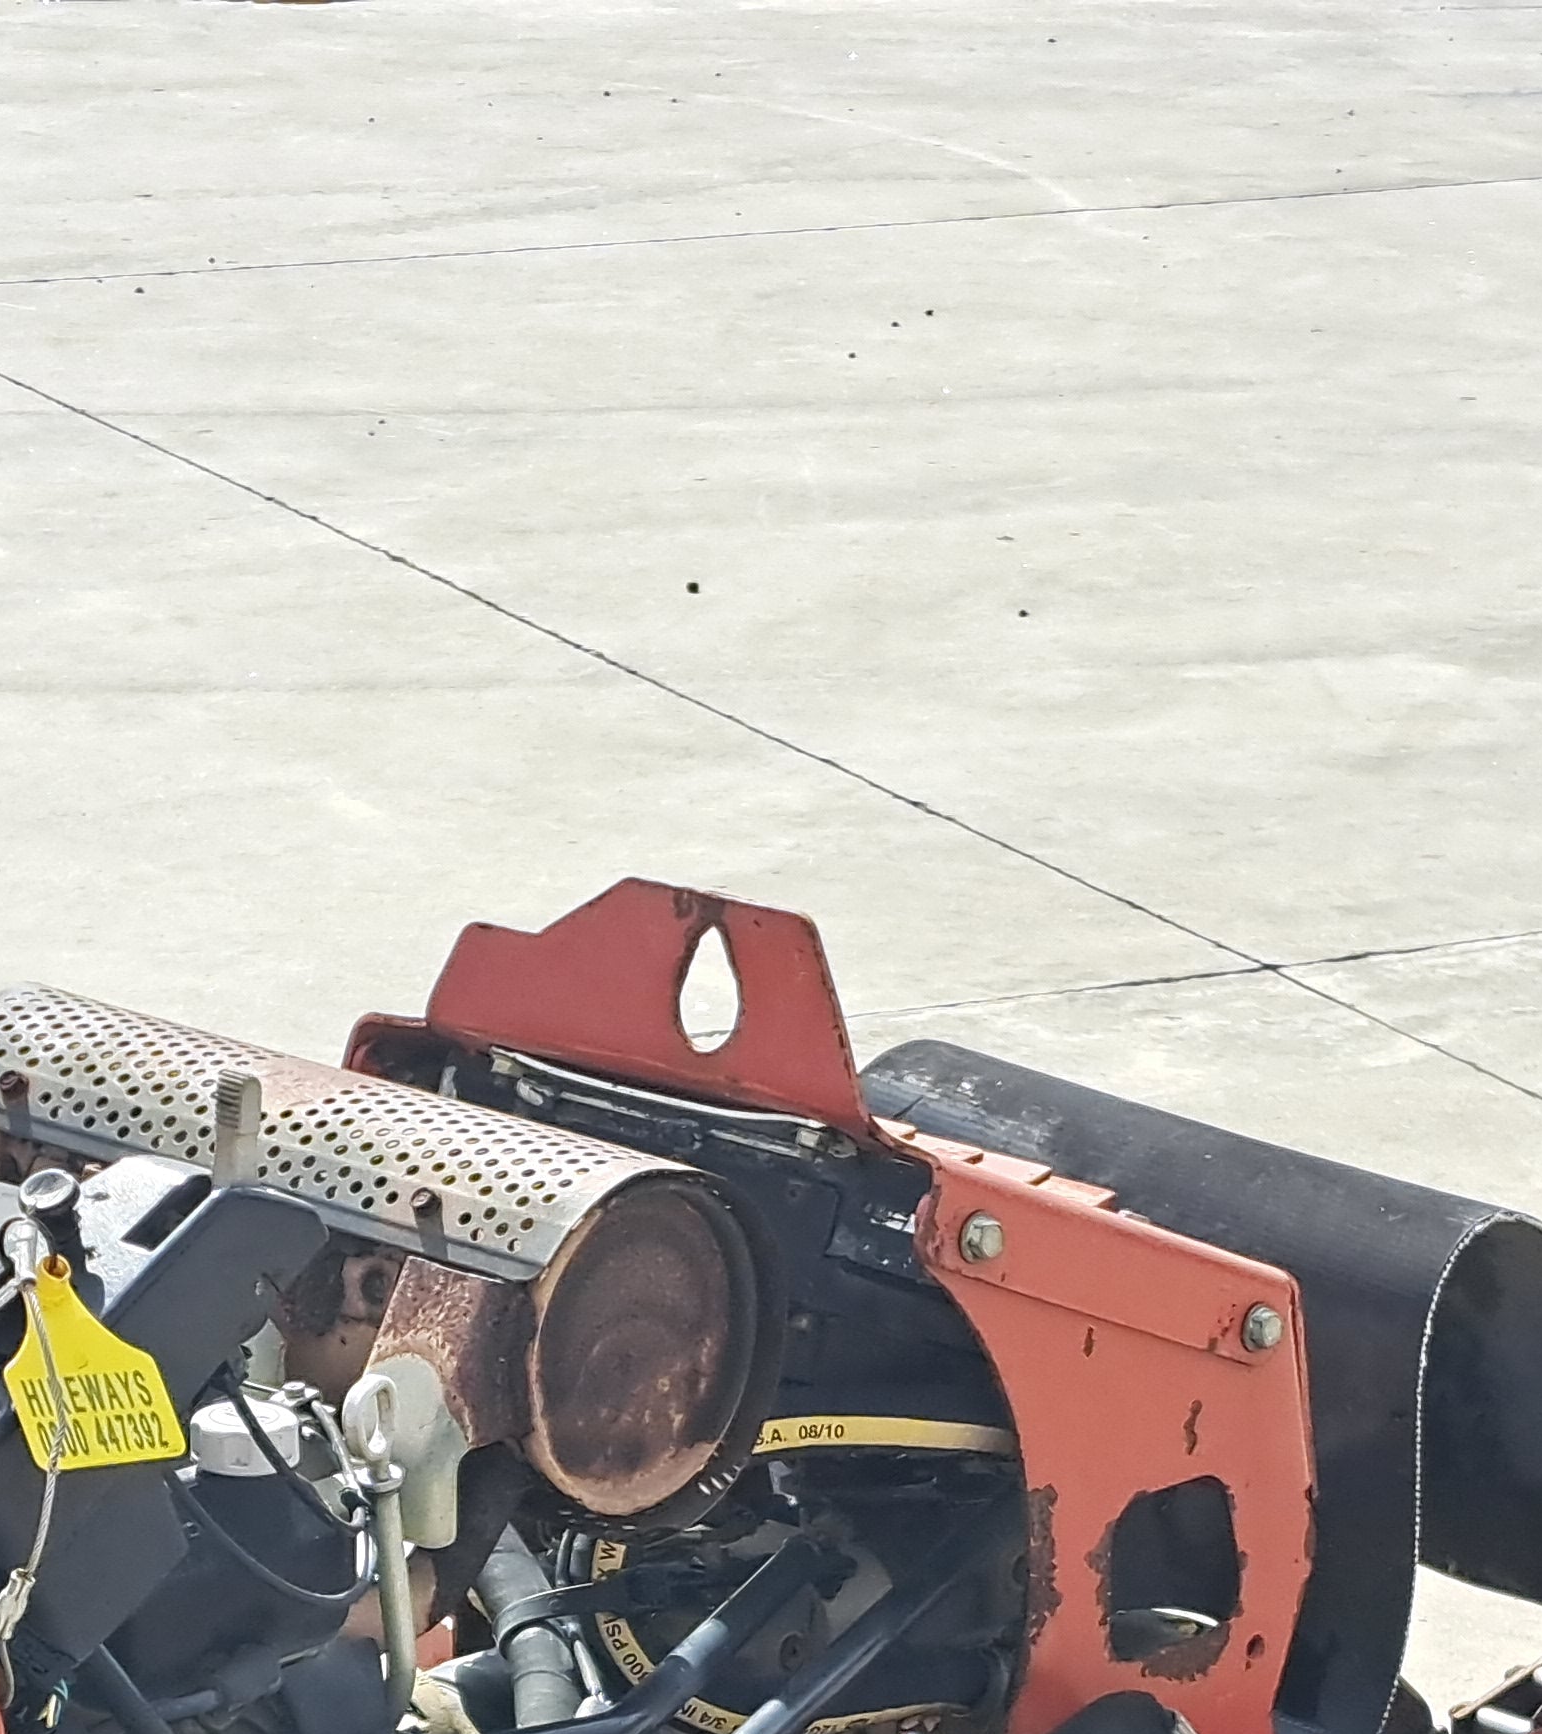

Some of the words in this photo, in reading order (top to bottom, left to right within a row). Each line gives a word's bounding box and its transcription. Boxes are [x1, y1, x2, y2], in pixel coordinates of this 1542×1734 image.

[20, 1370, 153, 1418] HIEWAYS
[94, 1411, 170, 1453] 447392
[798, 1423, 845, 1440] 08/10
[603, 1616, 629, 1651] PSI
[698, 1714, 728, 1730] 3/4
